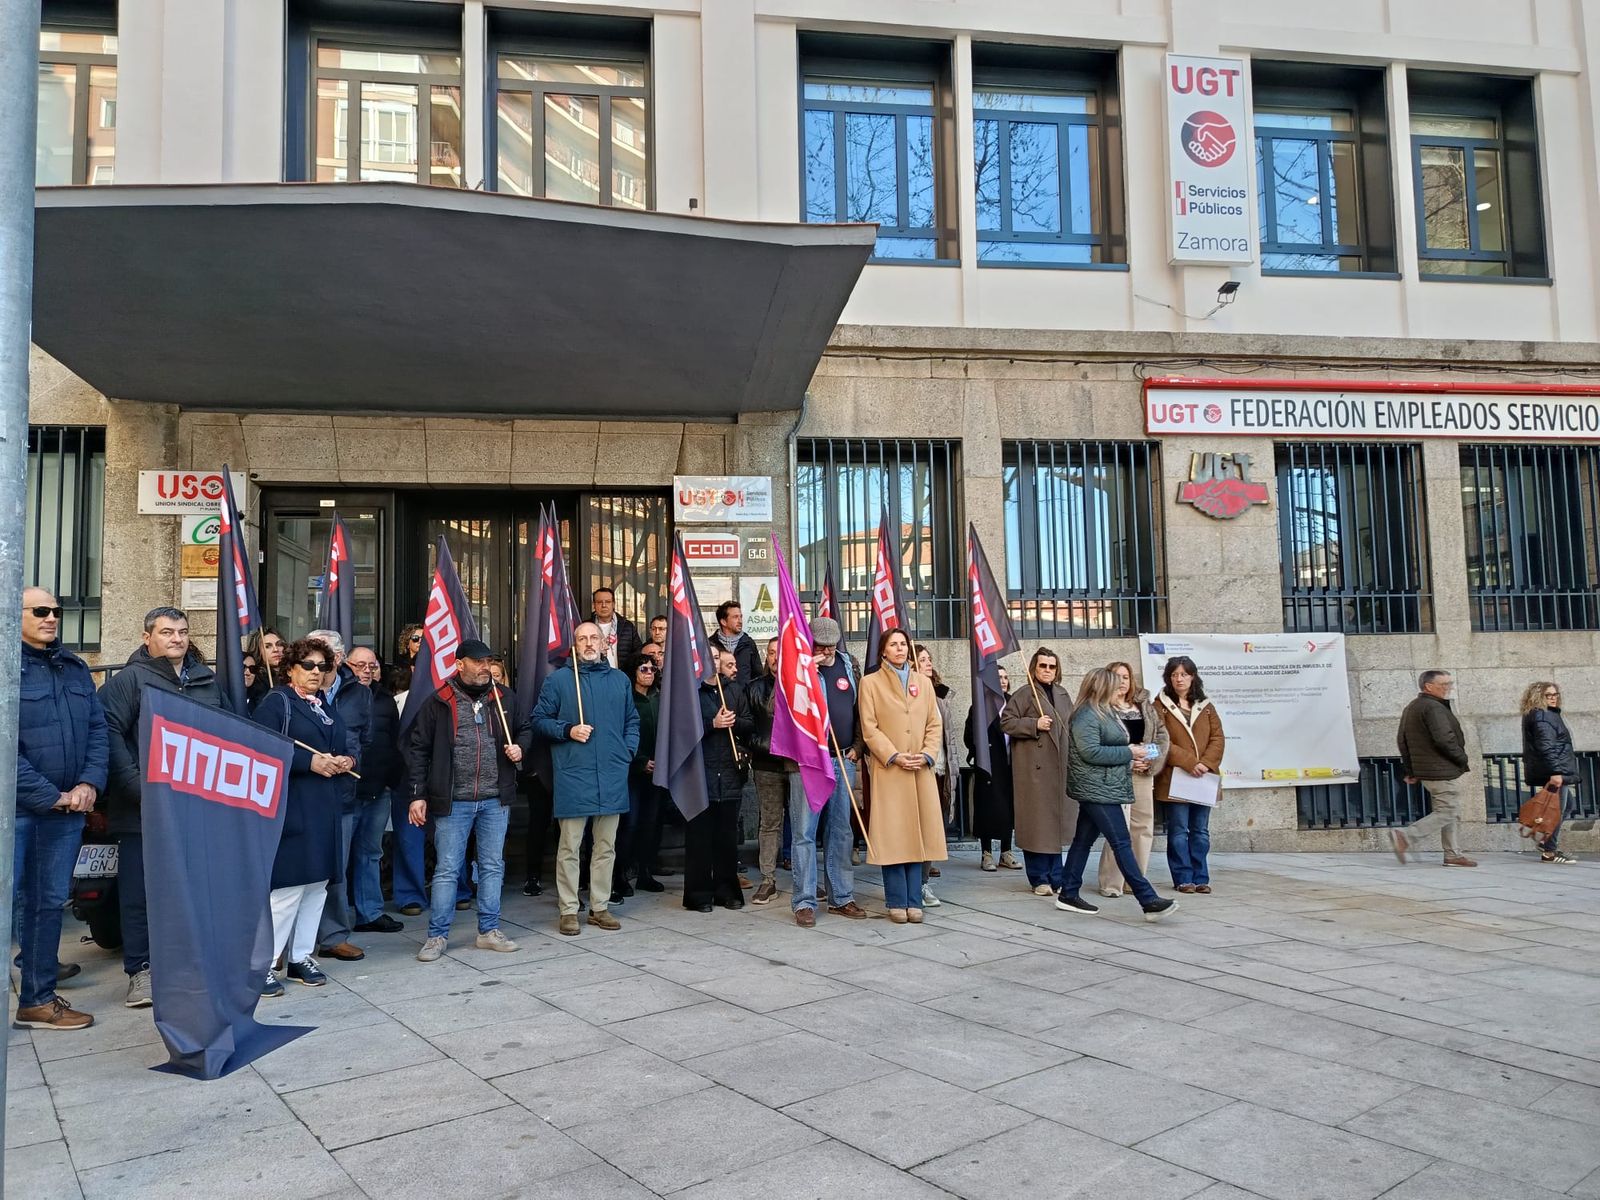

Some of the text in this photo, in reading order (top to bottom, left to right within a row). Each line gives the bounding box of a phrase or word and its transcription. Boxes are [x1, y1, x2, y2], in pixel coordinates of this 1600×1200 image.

[1171, 65, 1240, 97] UGT
[1188, 185, 1246, 199] Servicios
[1189, 202, 1243, 216] Públicos
[1177, 232, 1248, 251] Zamora
[1151, 394, 1599, 431] UGT FEDERACIÓN EMPLEADOS SERVICIO
[1189, 452, 1250, 483] UGT
[158, 474, 224, 500] USO
[679, 488, 716, 506] UGT
[688, 544, 734, 555] CCOO
[747, 615, 779, 624] ASAJA
[90, 860, 117, 872] GNJ
